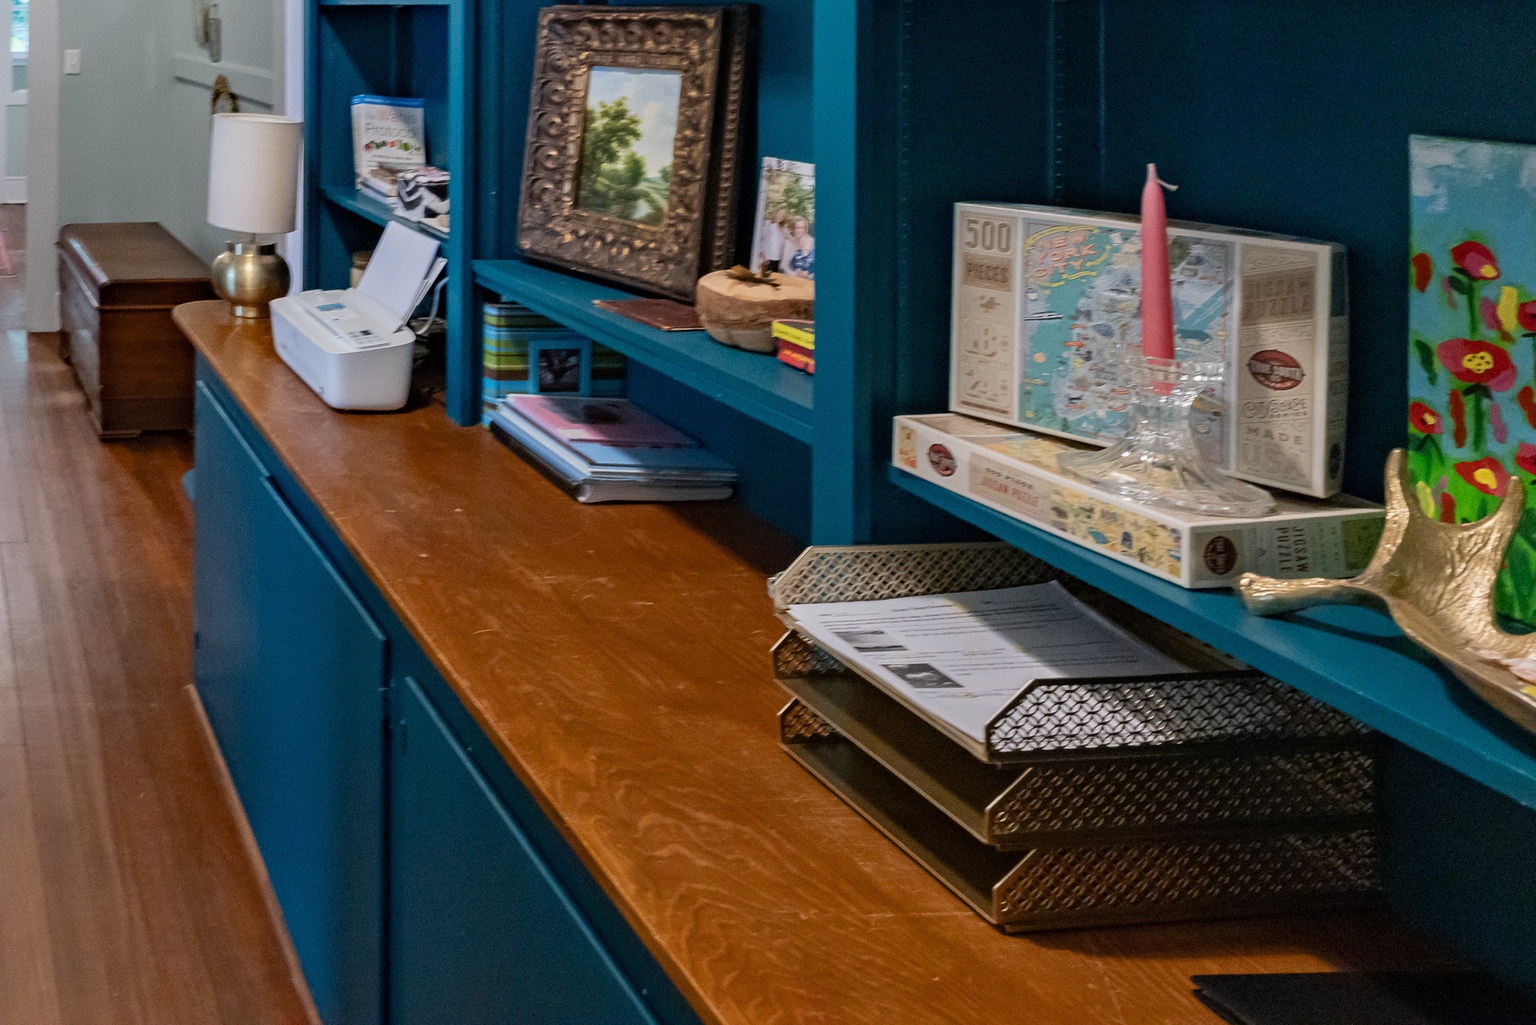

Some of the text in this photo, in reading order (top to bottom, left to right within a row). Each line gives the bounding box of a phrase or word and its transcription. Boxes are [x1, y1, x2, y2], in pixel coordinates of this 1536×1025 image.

[965, 218, 1012, 253] 500
[1037, 232, 1088, 252] NEW
[1036, 243, 1099, 265] YORK
[967, 262, 1009, 284] PIECES
[1033, 258, 1086, 278] CITY
[1277, 527, 1293, 571] PUZZLE
[1293, 526, 1309, 573] JIGSAW
